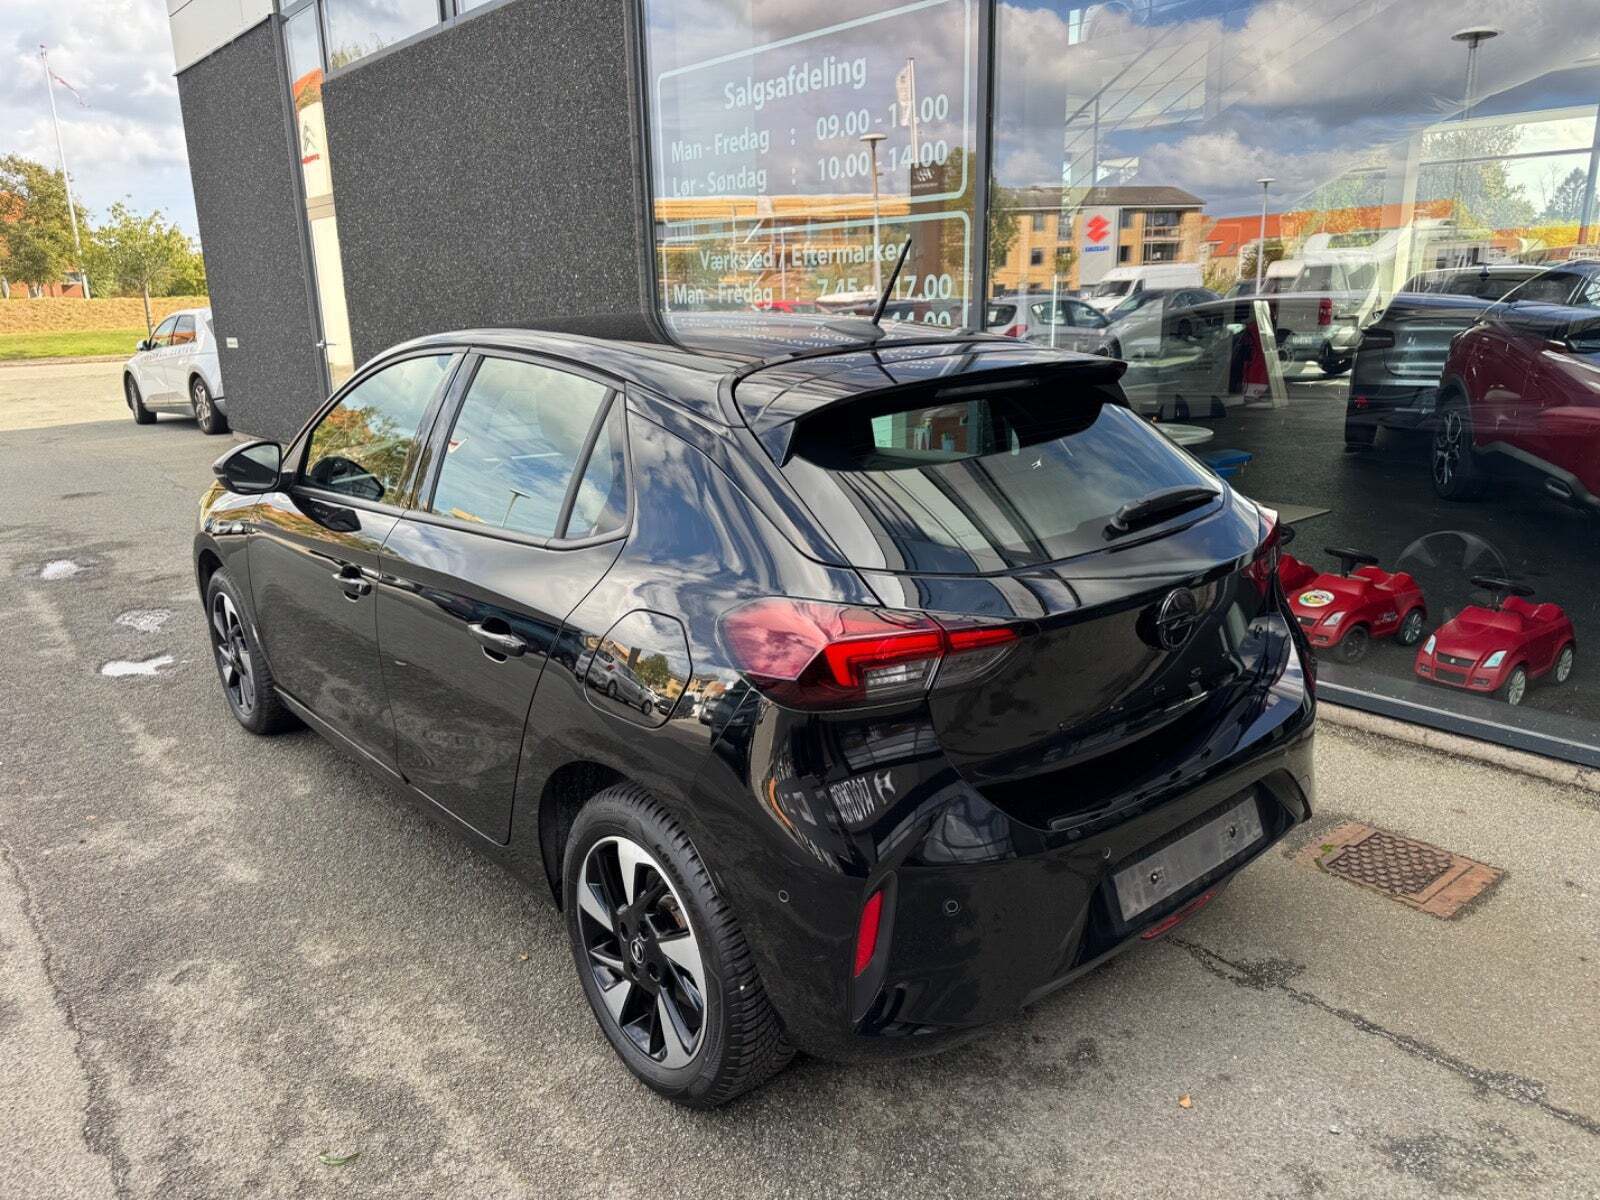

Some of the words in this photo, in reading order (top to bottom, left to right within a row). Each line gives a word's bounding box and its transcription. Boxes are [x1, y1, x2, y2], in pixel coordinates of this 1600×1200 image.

[724, 56, 867, 111] Salgsafdeling
[671, 140, 702, 164] Man
[714, 127, 770, 154] Fredag
[790, 128, 796, 146] :
[816, 108, 870, 141] 09.00
[673, 176, 697, 198] Lør
[707, 165, 767, 193] Søndag
[817, 151, 870, 182] 10.00
[673, 284, 704, 305] Man
[718, 280, 773, 312] Fredag
[893, 274, 952, 300] 17.00
